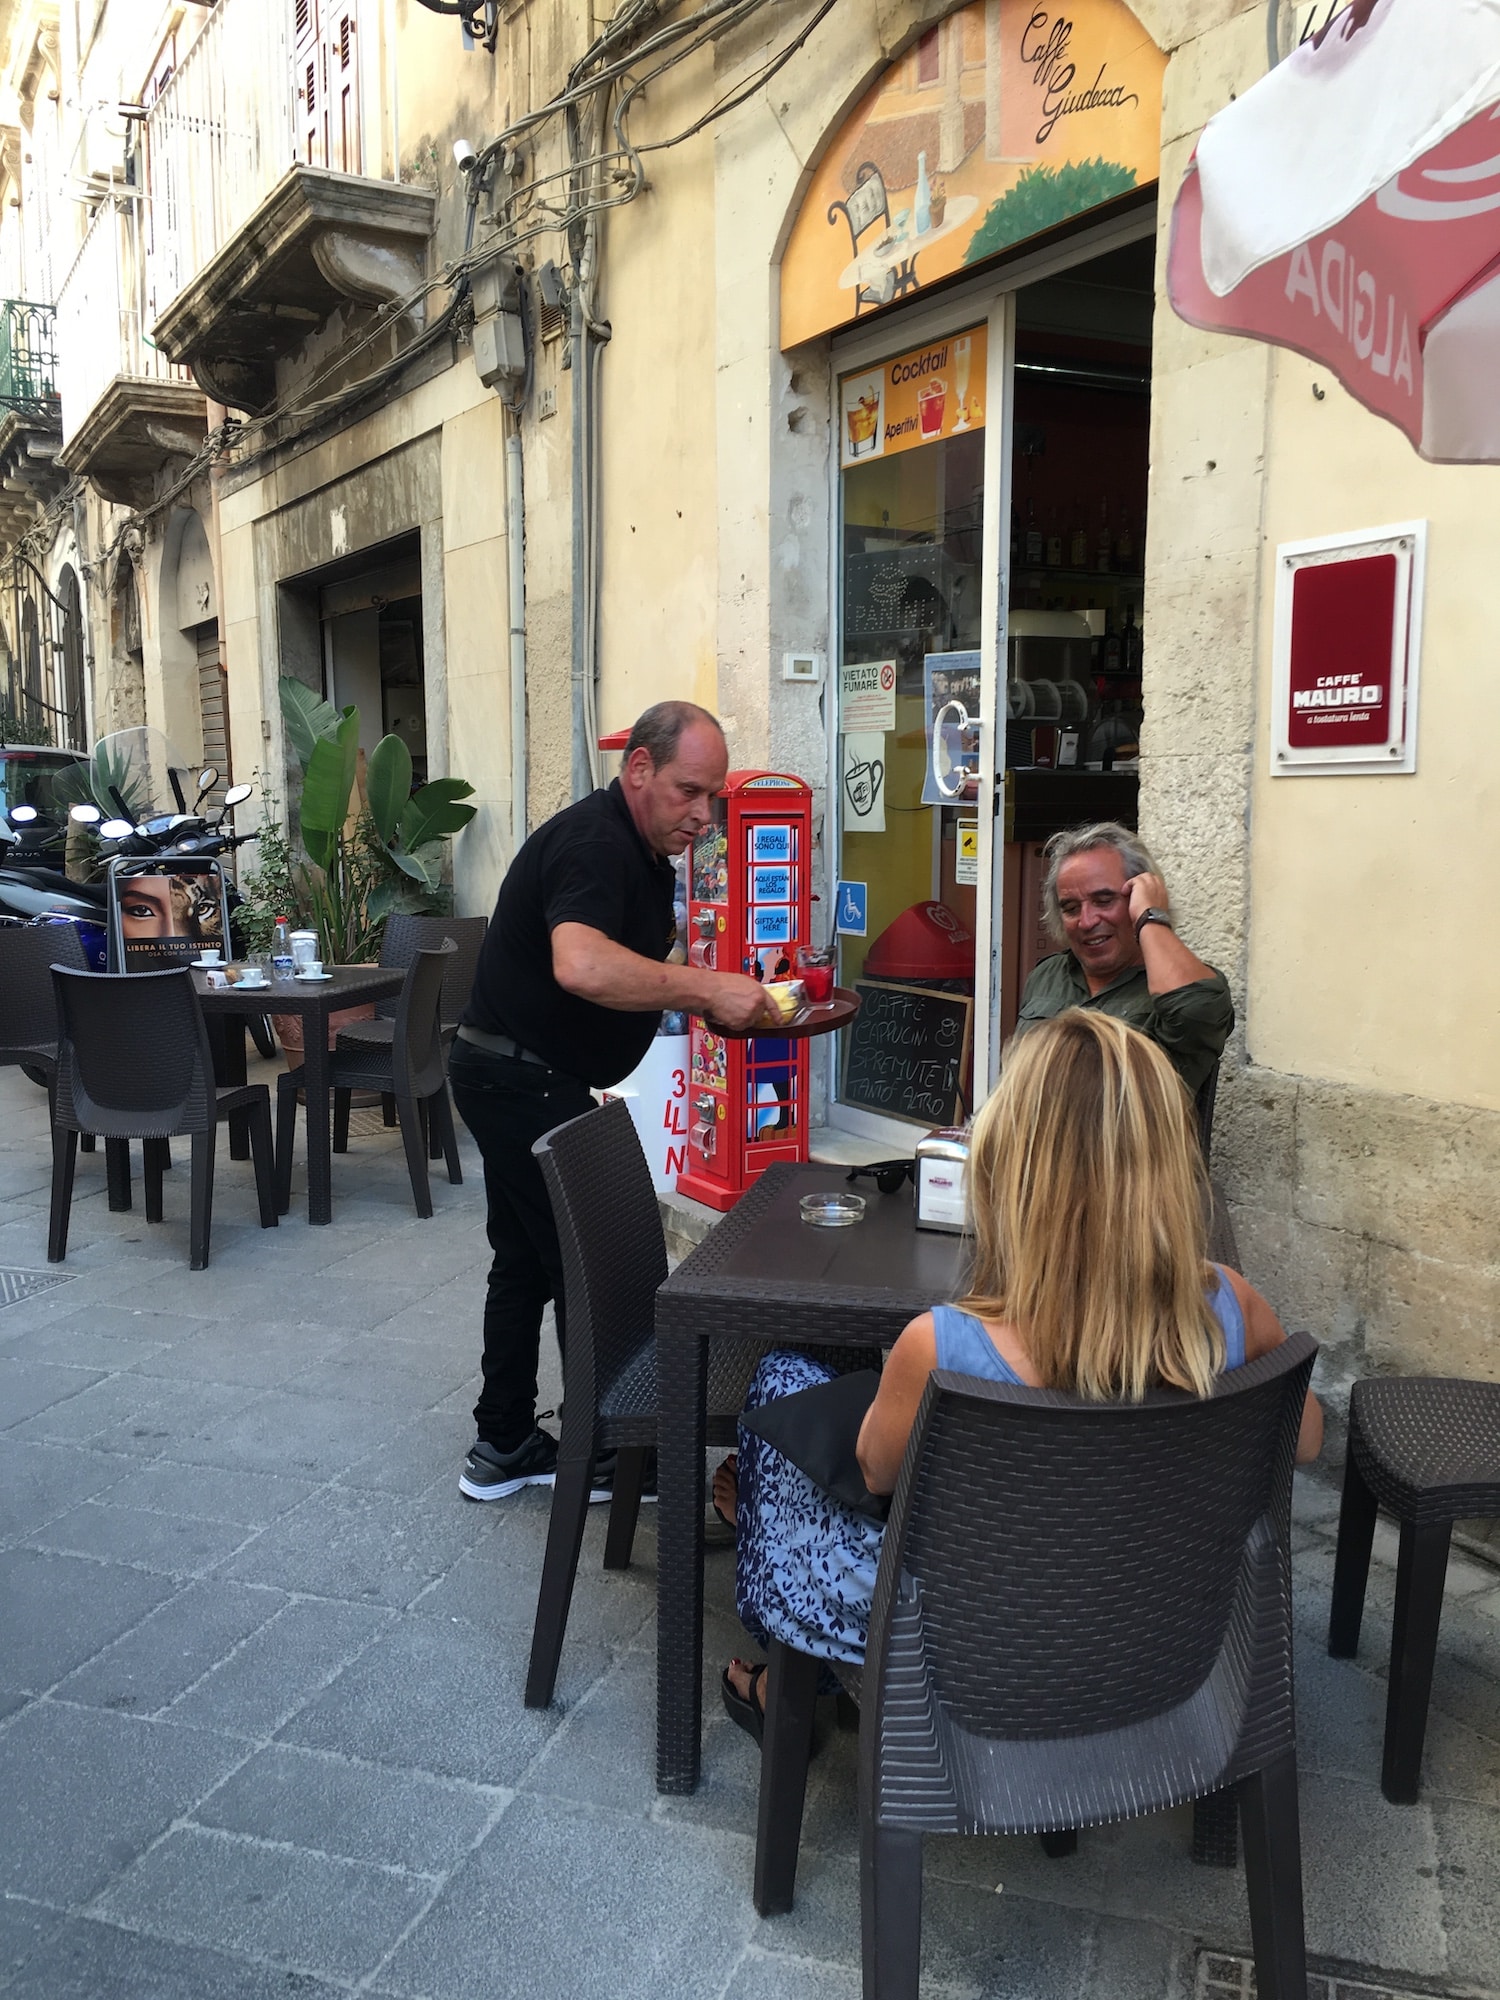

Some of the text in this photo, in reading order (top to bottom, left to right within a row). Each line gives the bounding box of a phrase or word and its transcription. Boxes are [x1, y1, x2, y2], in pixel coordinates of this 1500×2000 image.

[1036, 62, 1139, 144] Giudecca
[891, 346, 948, 385] Cocktail
[885, 415, 919, 441] Aperitivi
[855, 600, 925, 631] PANINI
[843, 668, 878, 681] VIETATO
[843, 680, 878, 692] FUMARE
[1293, 685, 1383, 708] MAURO
[1349, 712, 1370, 721] lenta
[126, 944, 156, 952] LIBERA
[189, 941, 222, 949] ISTINTO
[851, 1047, 942, 1088] SPREMUTE
[903, 1086, 944, 1116] ALTRO
